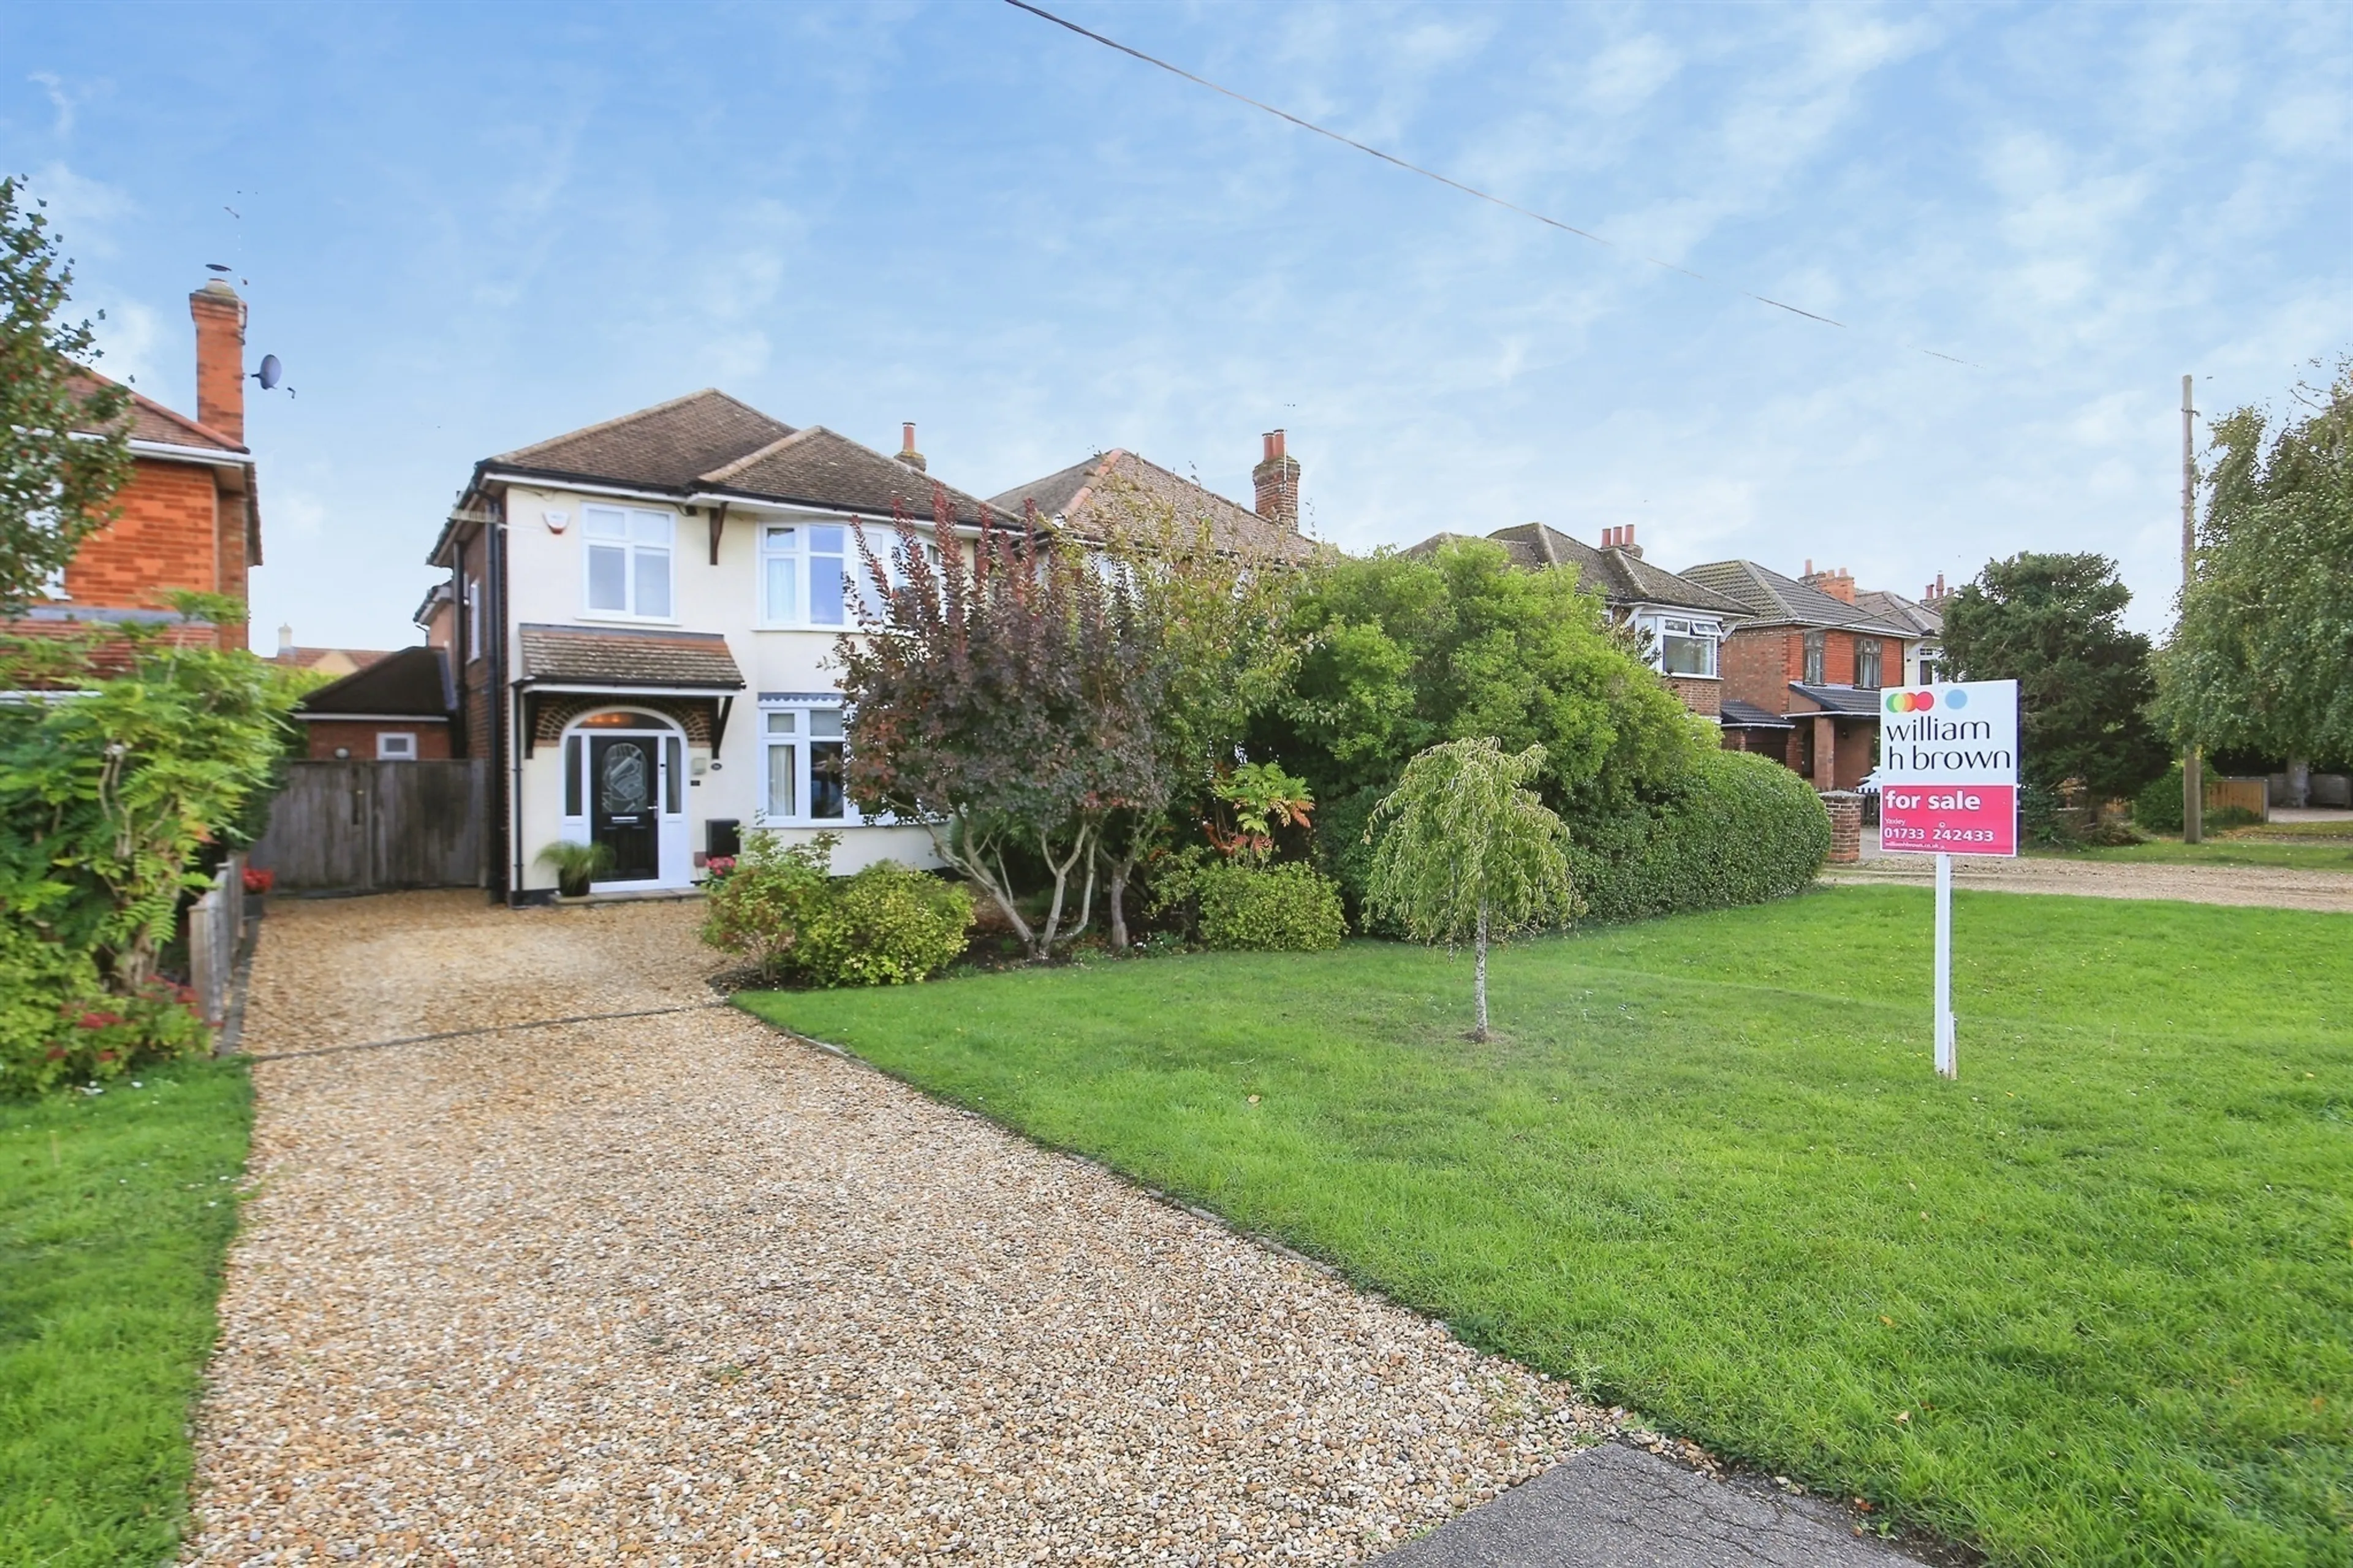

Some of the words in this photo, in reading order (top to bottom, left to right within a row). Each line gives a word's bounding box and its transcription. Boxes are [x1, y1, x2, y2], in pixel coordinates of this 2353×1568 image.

[1886, 716, 1990, 741] william
[1889, 746, 1903, 770] h
[1912, 745, 2010, 770] brown
[1885, 790, 1920, 809] for
[1928, 790, 1981, 810] sale
[1884, 827, 1925, 839] 01733
[1932, 828, 1995, 842] 242433
